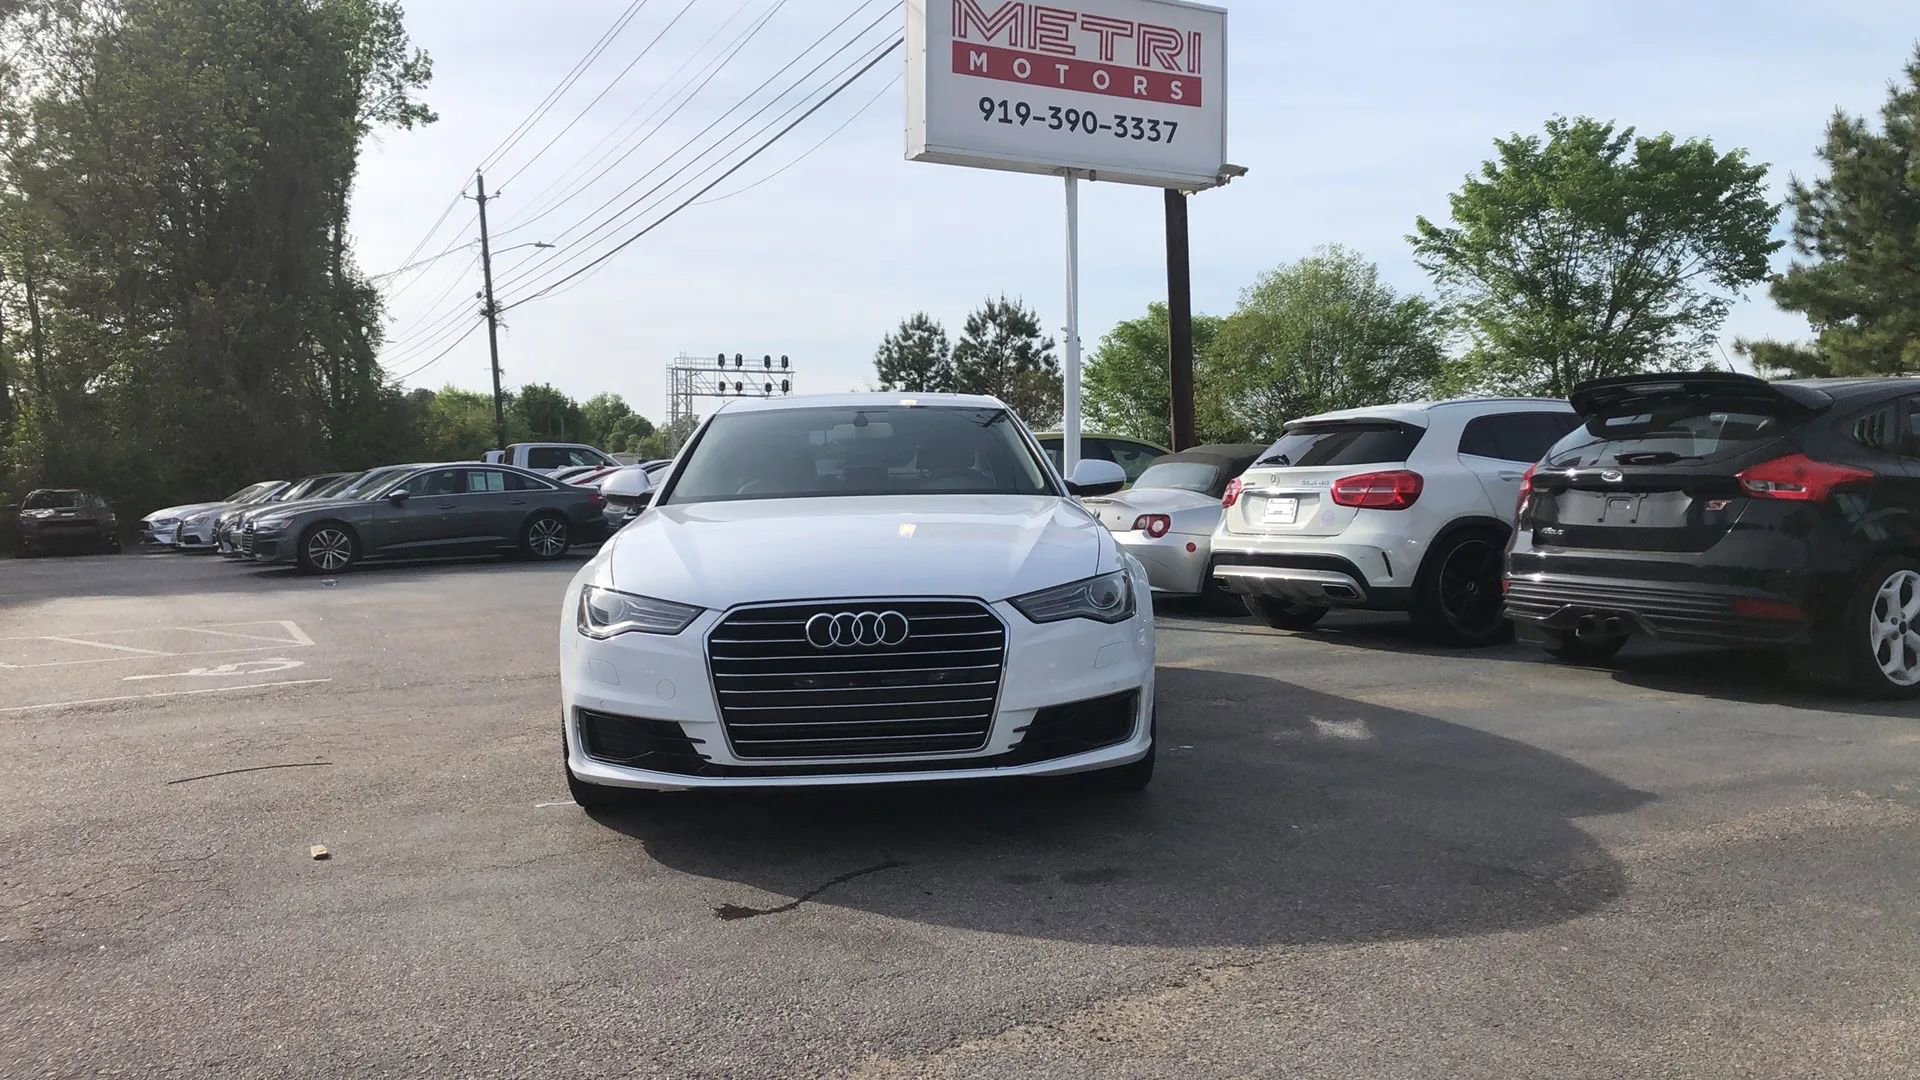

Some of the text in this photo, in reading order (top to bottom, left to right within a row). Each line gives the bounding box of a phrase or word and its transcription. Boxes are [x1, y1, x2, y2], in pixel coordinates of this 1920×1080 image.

[952, 0, 1202, 74] METRI
[969, 50, 1184, 100] MOTORS
[978, 96, 1178, 144] 919-390-3337
